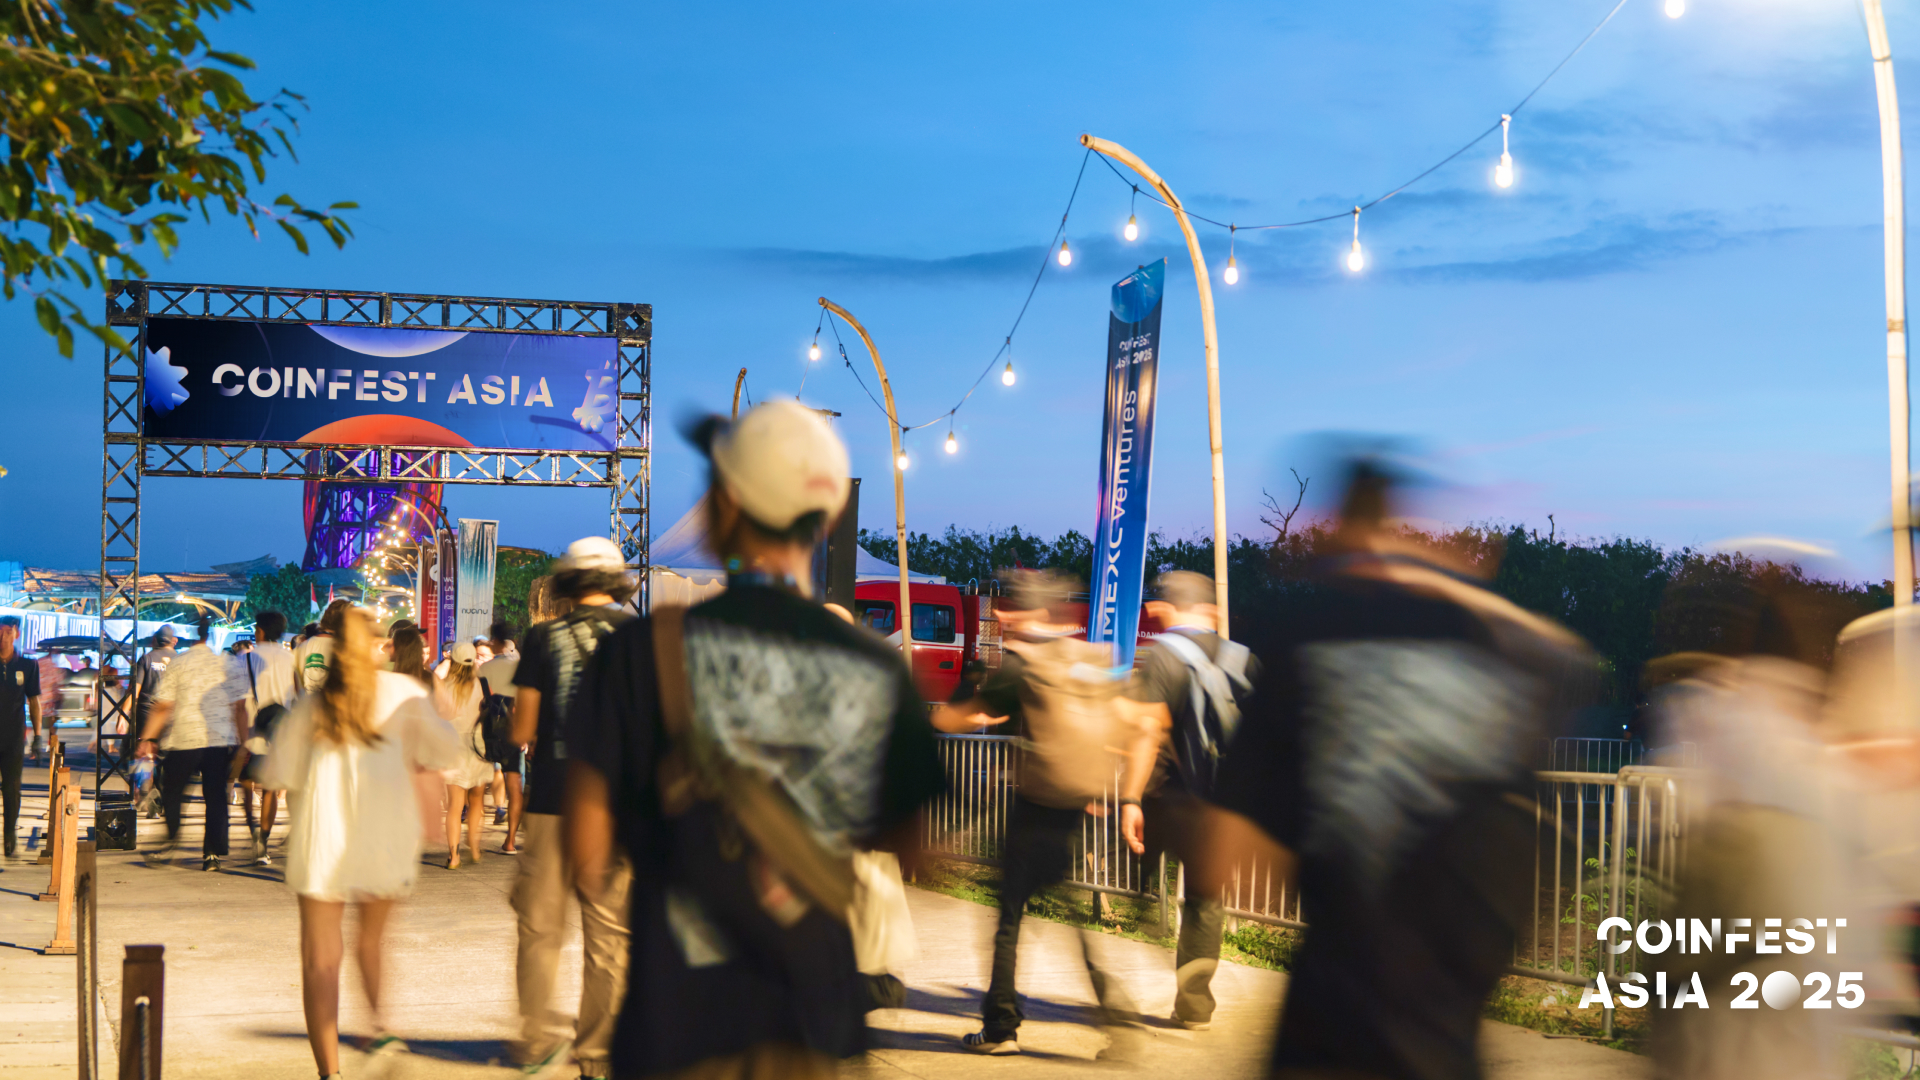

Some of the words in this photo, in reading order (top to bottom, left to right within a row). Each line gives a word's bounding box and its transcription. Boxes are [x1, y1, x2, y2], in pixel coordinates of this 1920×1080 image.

[212, 363, 436, 402] COINFEST
[447, 373, 554, 407] ASIA
[1103, 527, 1123, 635] MEXC
